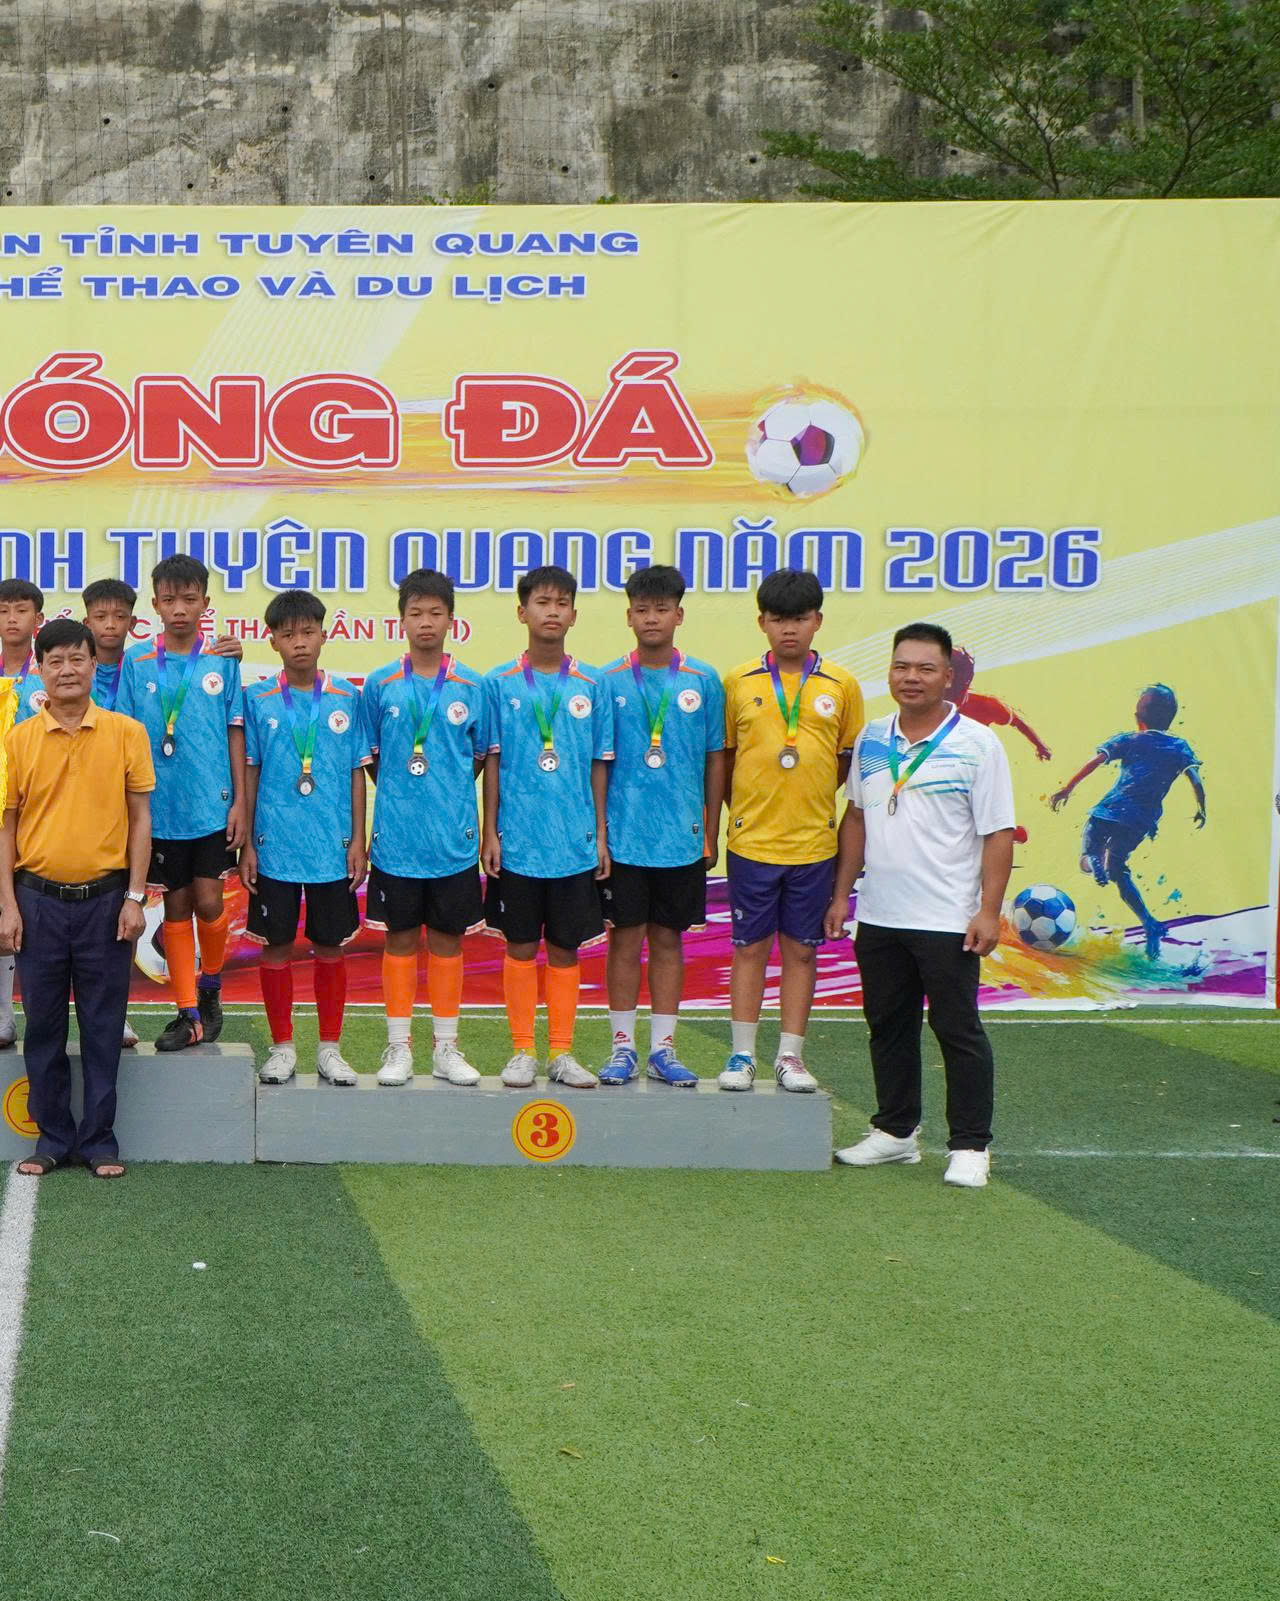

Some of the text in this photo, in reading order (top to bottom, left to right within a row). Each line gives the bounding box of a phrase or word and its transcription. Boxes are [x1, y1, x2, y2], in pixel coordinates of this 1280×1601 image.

[61, 227, 199, 254] TỈNH
[220, 228, 414, 254] TUYÊN
[435, 231, 639, 255] QUANG
[84, 275, 241, 297] THAO
[259, 272, 336, 297] VÀ
[357, 276, 433, 297] DU
[454, 275, 586, 302] LỊCH
[442, 350, 714, 469] ĐÁ
[109, 519, 366, 590] TUYÊN
[393, 530, 653, 590] QUANG
[679, 518, 863, 590] NĂM
[889, 529, 1101, 590] 2026
[530, 1112, 560, 1148] 3
